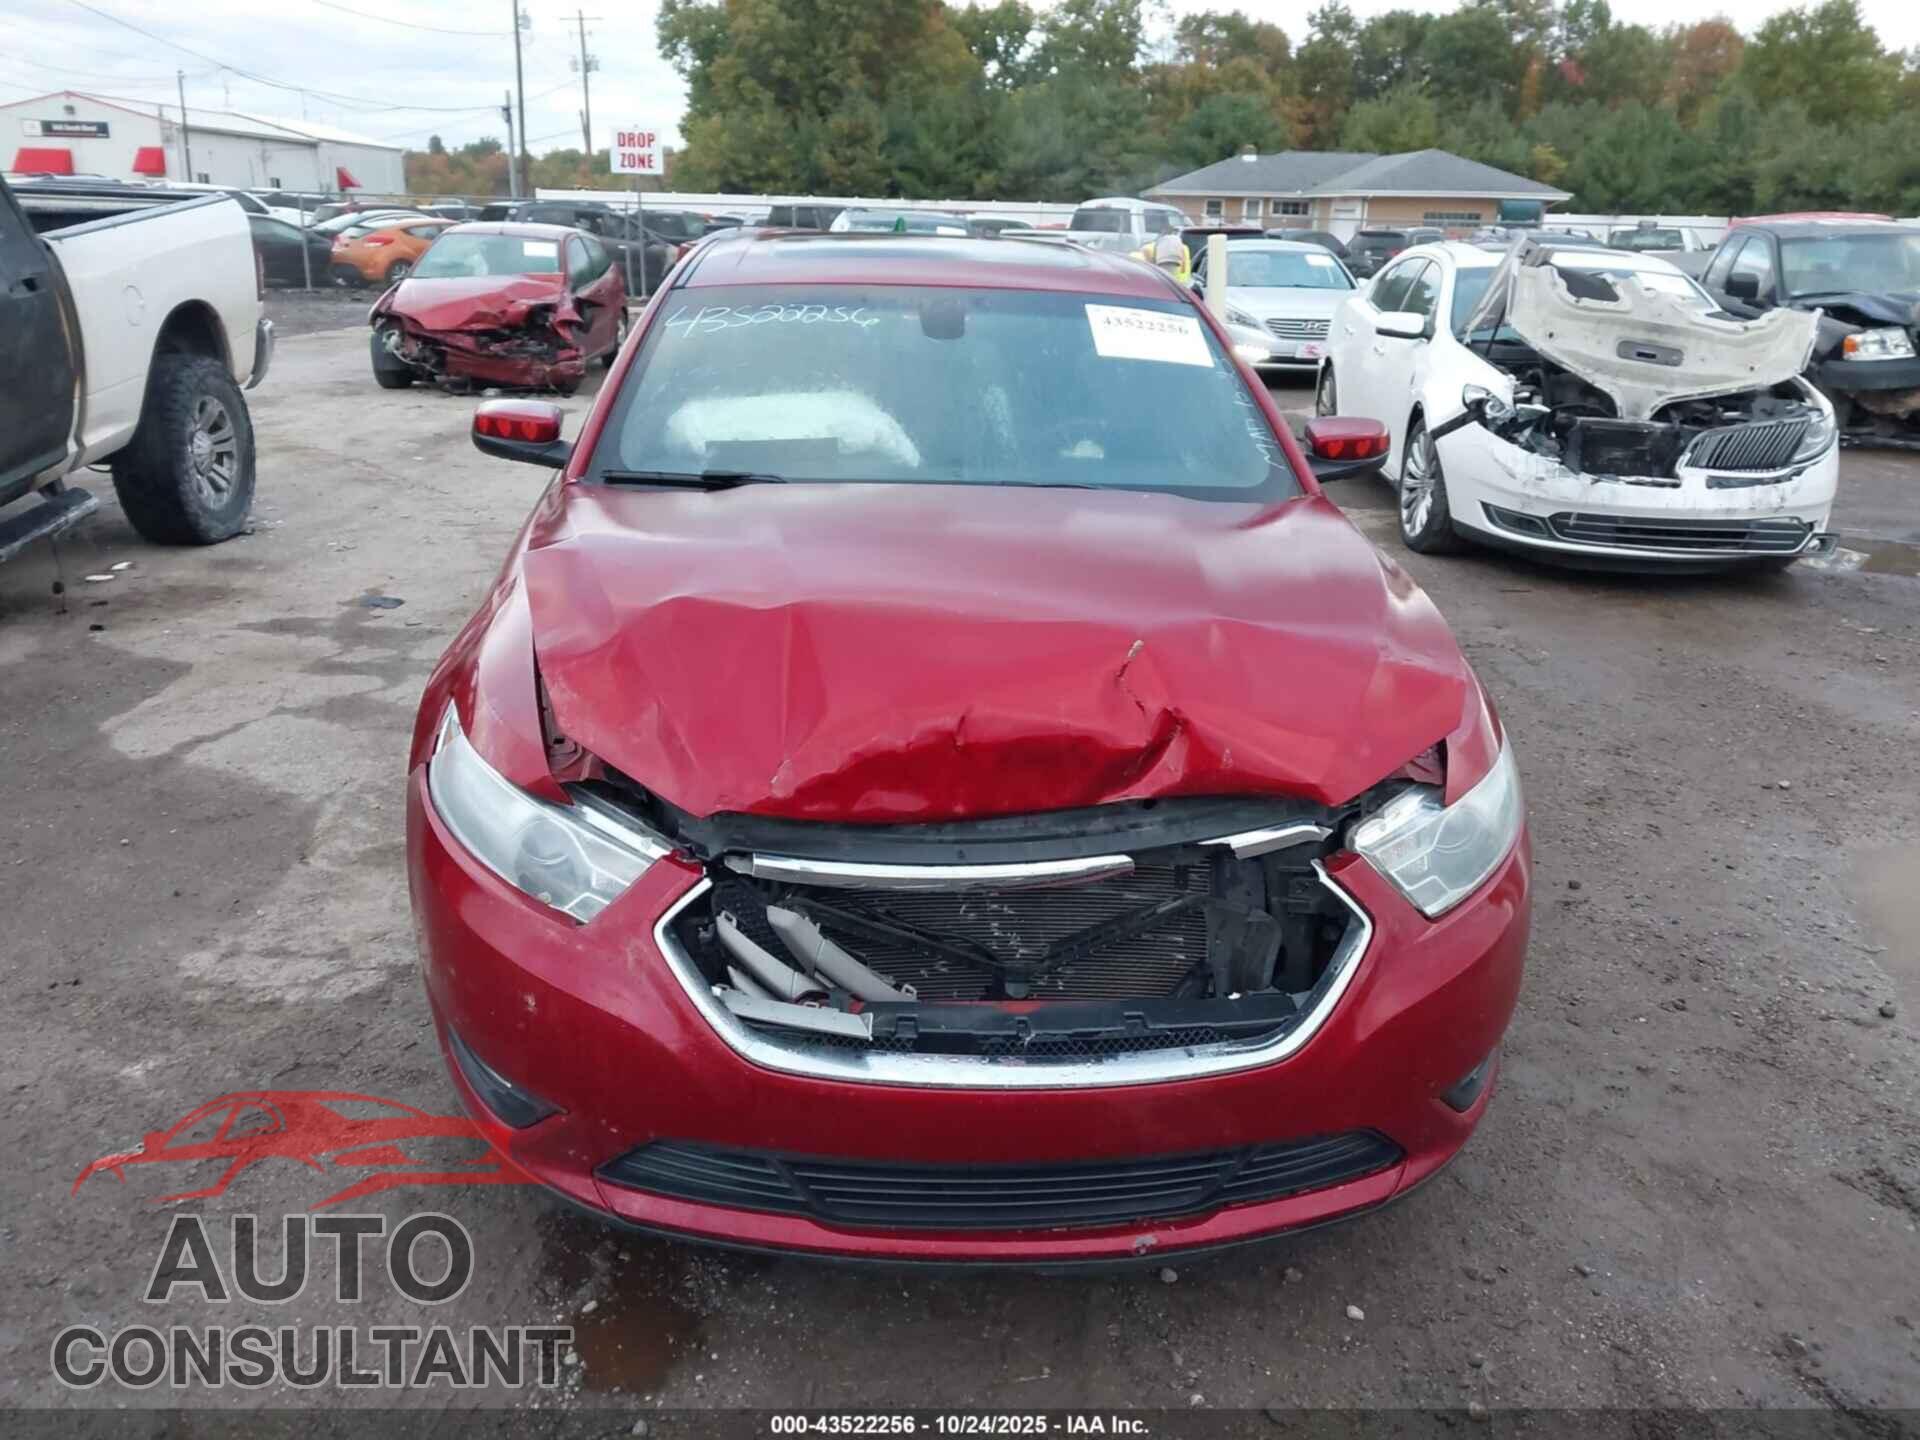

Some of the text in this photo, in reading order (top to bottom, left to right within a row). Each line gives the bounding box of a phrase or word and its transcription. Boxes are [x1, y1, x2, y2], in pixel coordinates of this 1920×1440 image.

[617, 131, 655, 148] DROP
[620, 152, 655, 169] ZONE
[664, 304, 880, 339] 43522256
